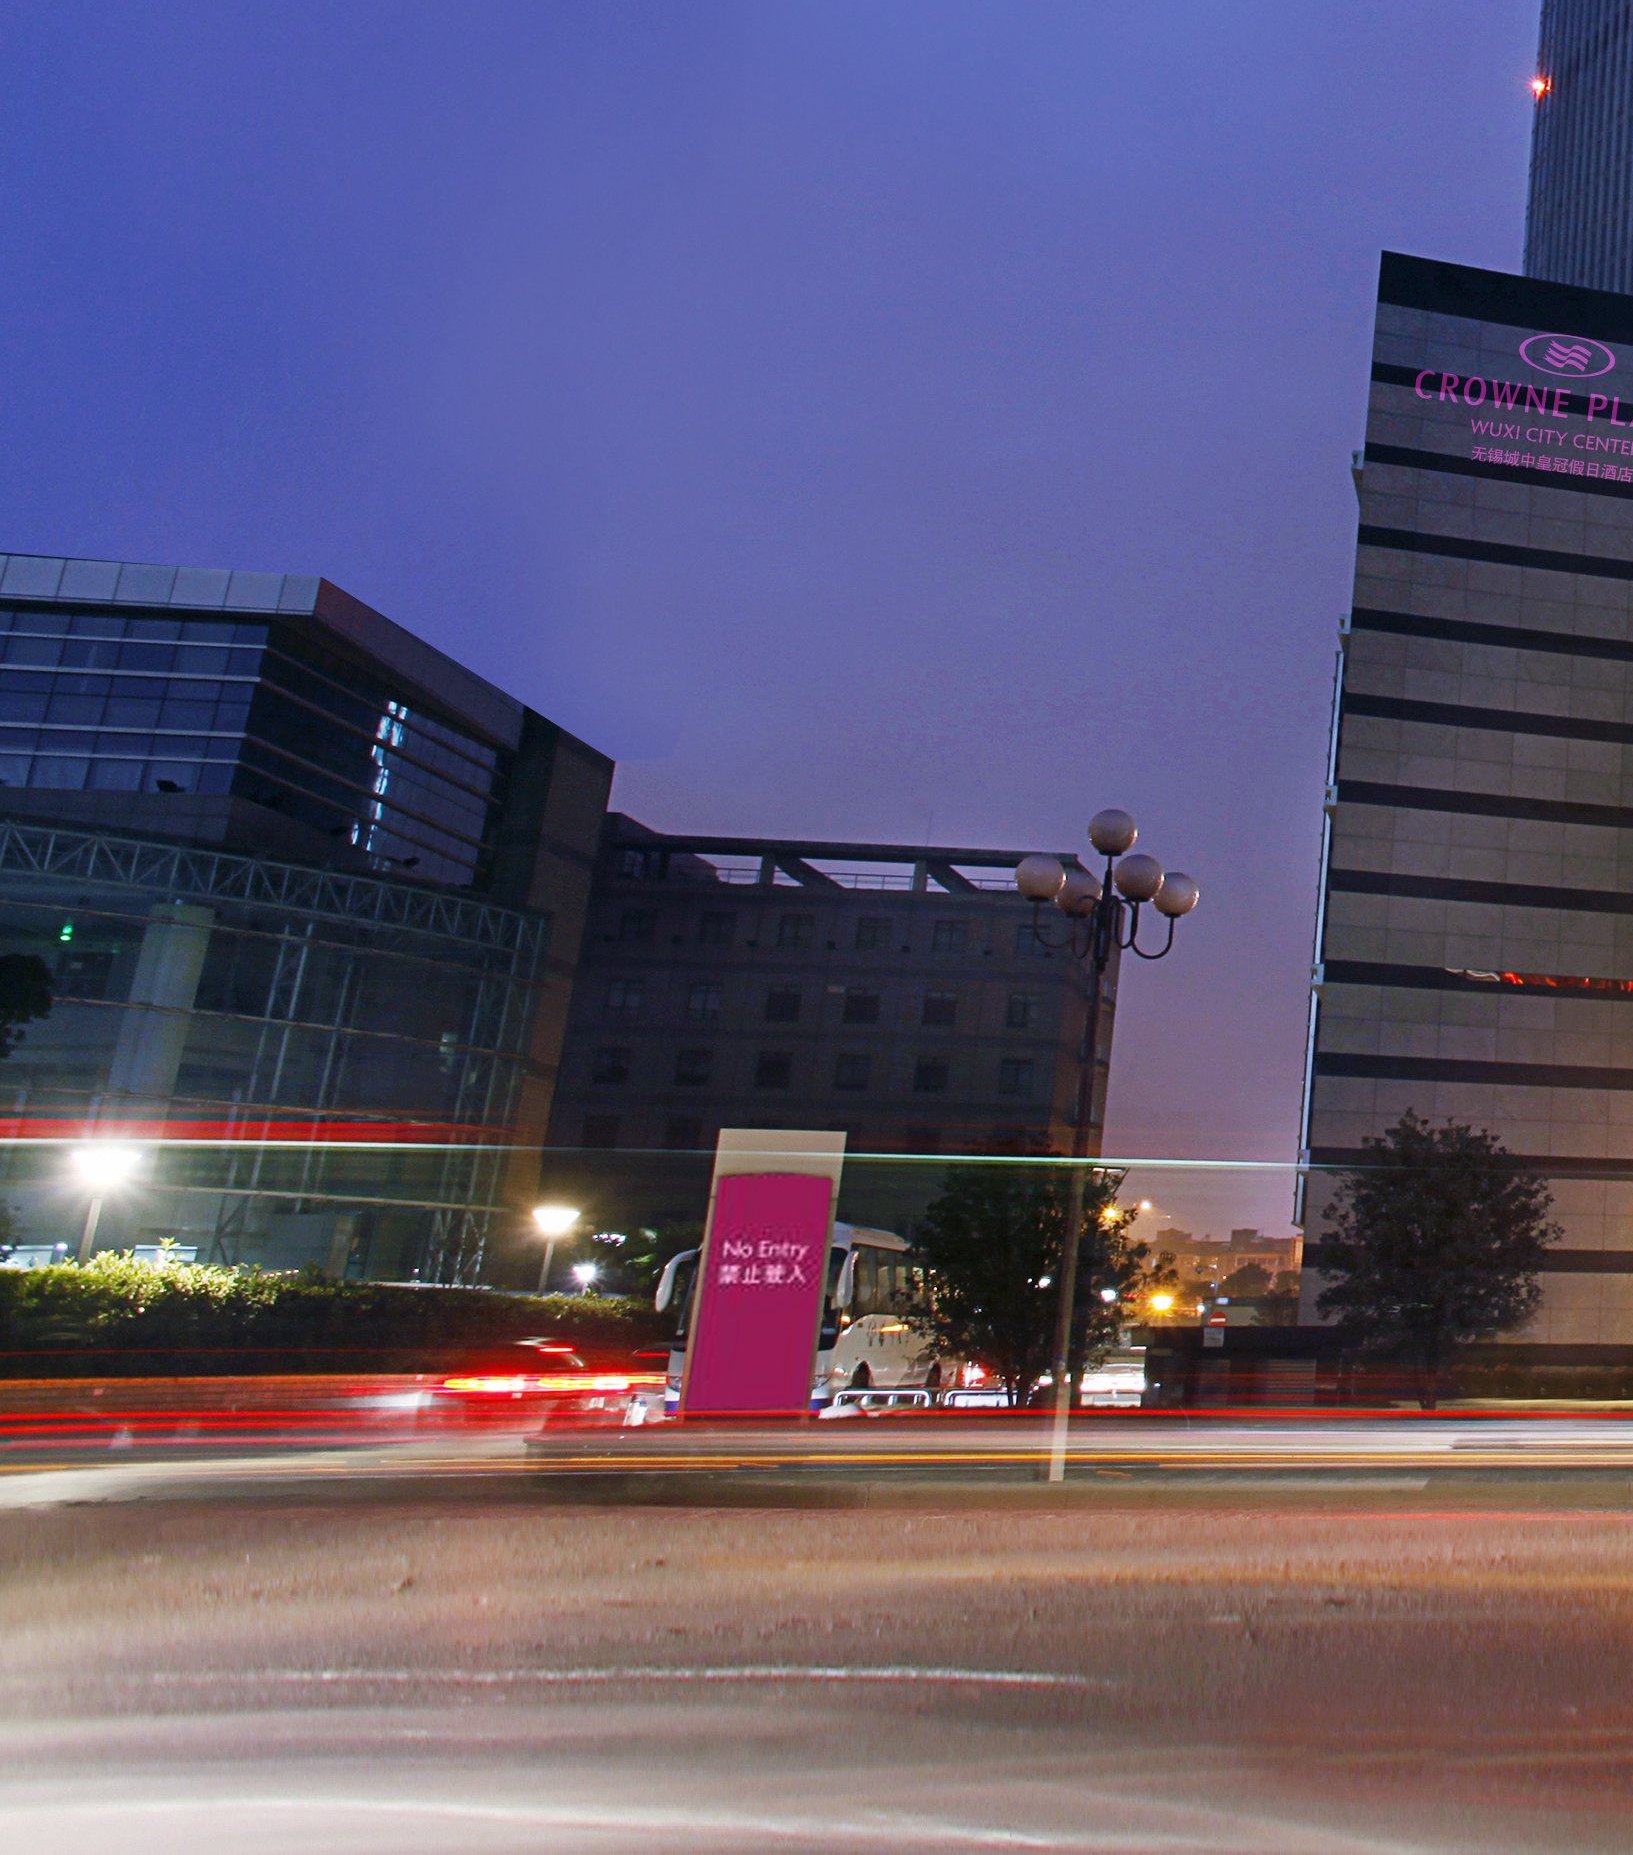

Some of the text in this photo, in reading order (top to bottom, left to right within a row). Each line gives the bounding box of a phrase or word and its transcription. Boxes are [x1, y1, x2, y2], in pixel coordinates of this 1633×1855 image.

[1414, 369, 1572, 419] CROWNE
[1470, 418, 1521, 440] WUXI
[1525, 426, 1569, 446] CITY
[1471, 446, 1633, 483] 无锡城中皇冠假日酒店
[722, 1240, 811, 1262] No Entry
